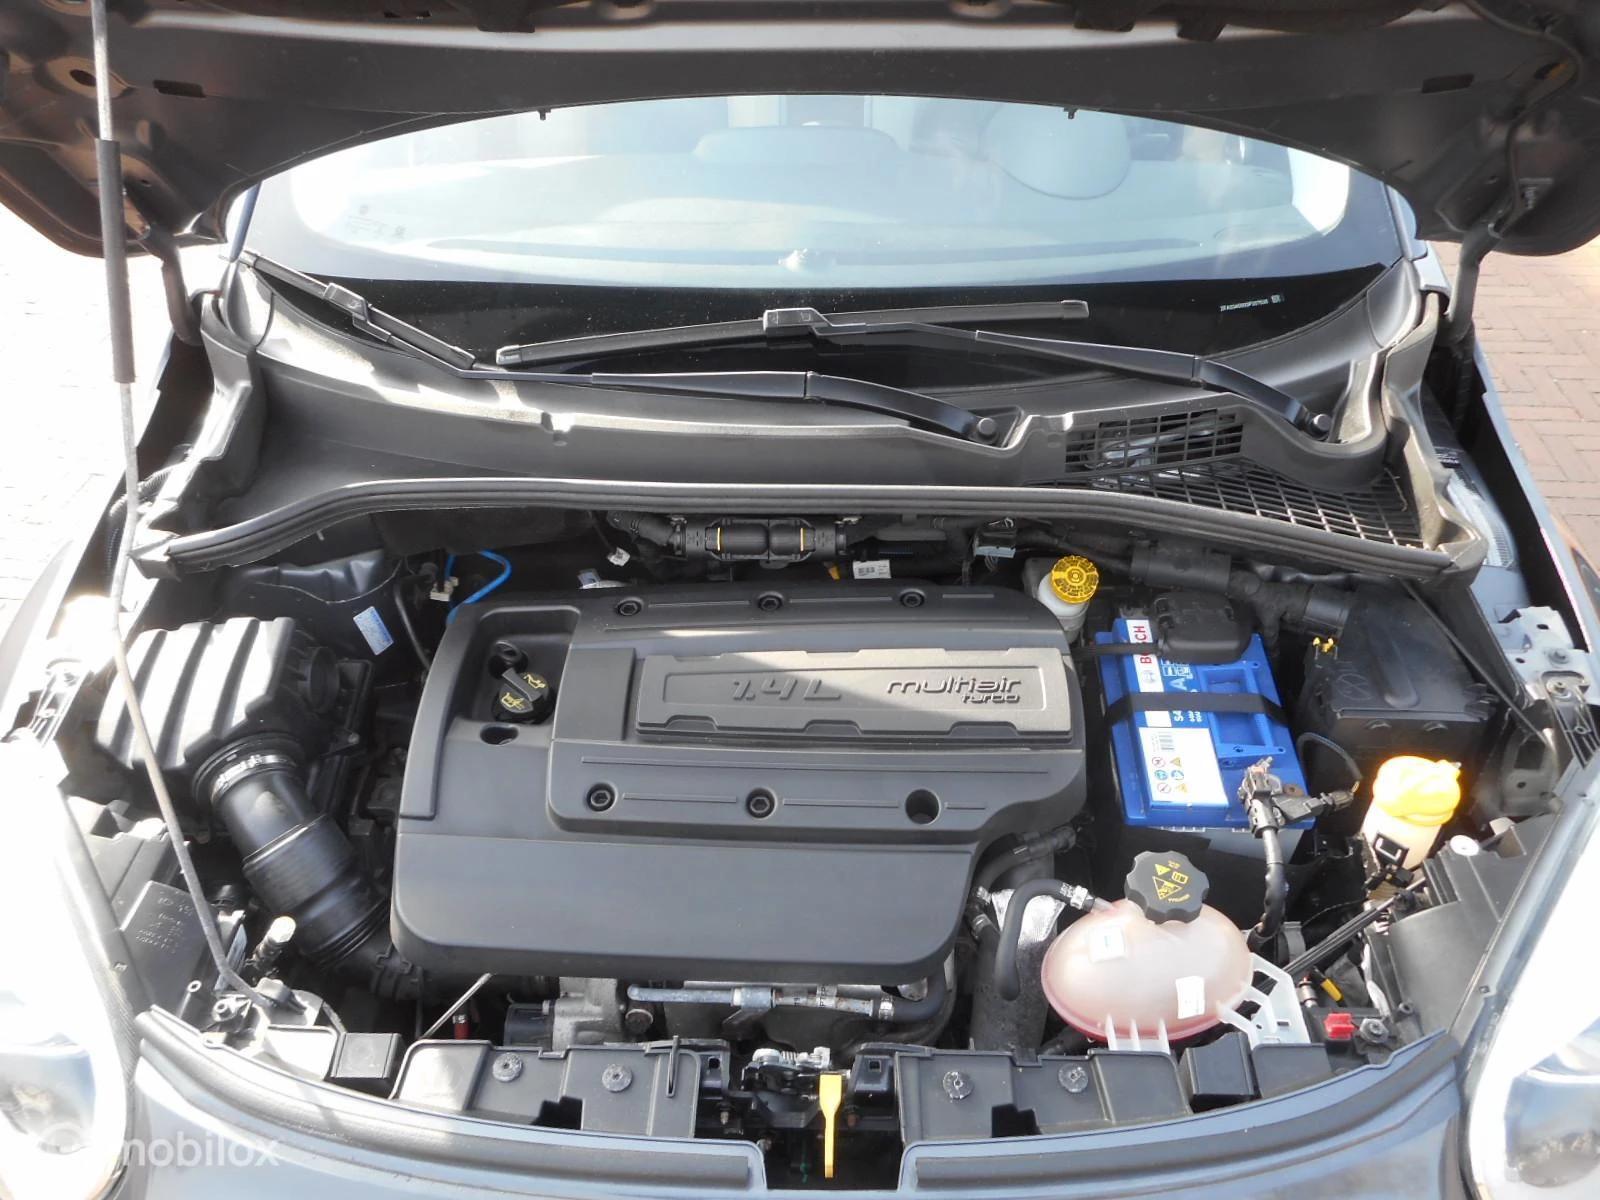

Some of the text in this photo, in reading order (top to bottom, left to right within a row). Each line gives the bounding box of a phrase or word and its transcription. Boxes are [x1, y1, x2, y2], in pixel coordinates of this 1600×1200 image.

[1133, 626, 1152, 664] BCH
[887, 675, 1021, 694] multiair
[962, 693, 1020, 704] turbo
